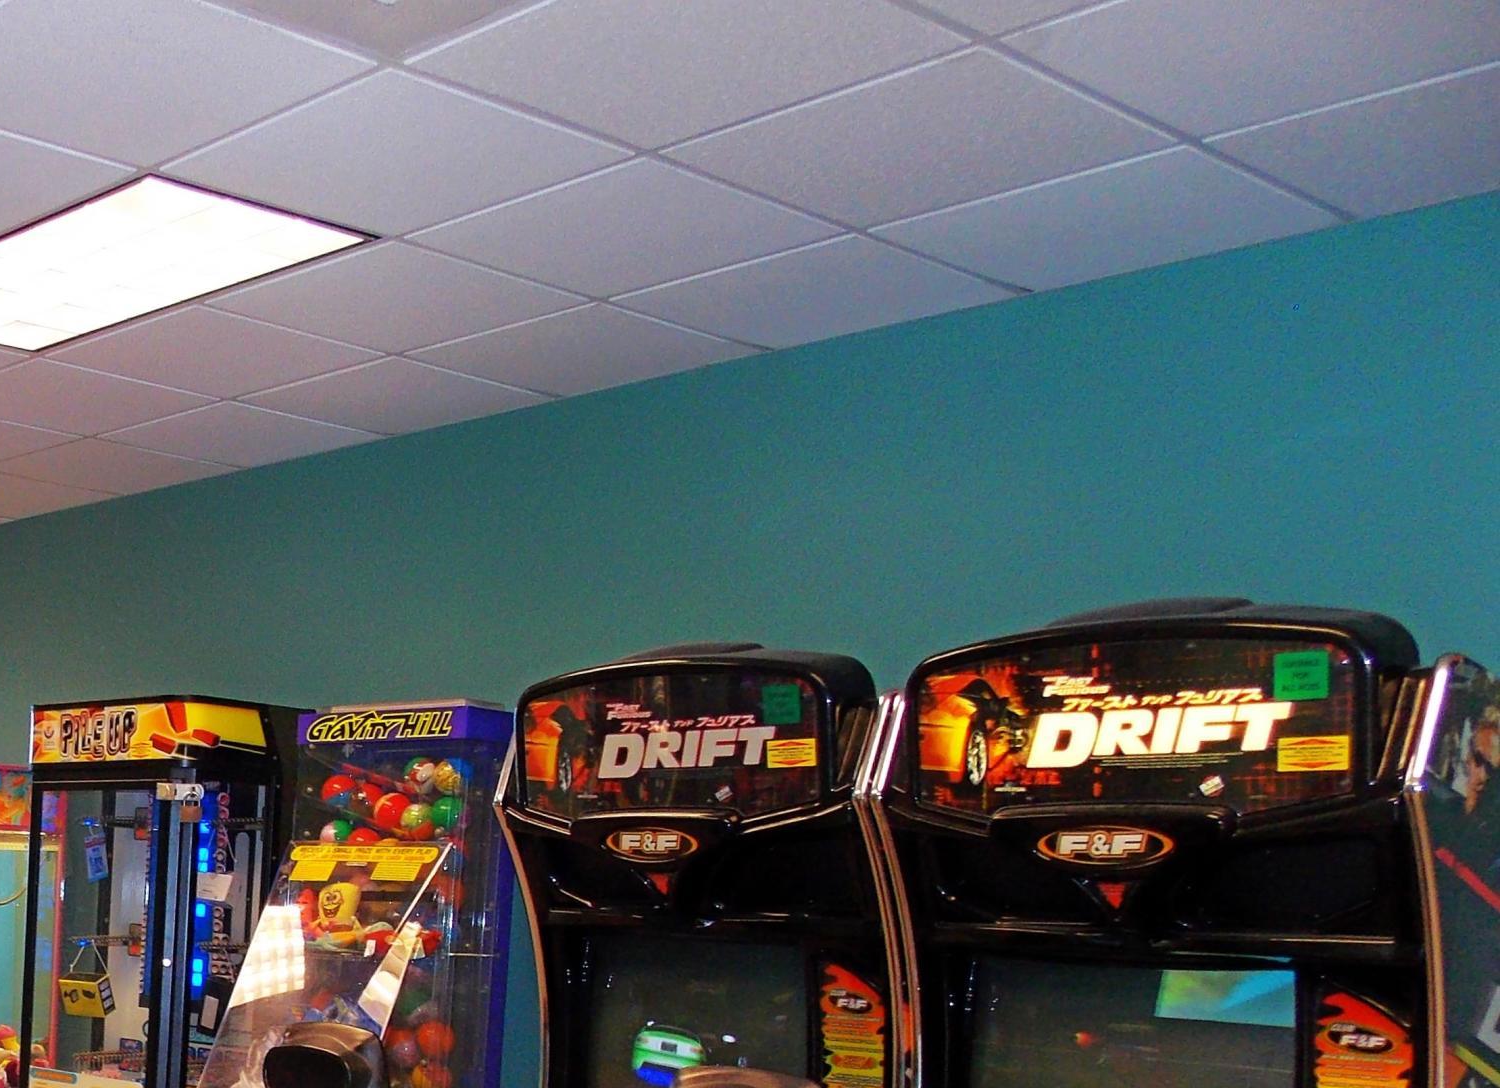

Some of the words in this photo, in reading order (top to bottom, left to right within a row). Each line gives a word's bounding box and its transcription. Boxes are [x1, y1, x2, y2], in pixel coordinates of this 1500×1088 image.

[60, 709, 105, 760] PILE
[106, 706, 138, 756] UP
[597, 725, 776, 779] DRIFT
[1026, 701, 1293, 768] DRIFT
[619, 832, 680, 853] F&F
[1056, 831, 1147, 858] F&F
